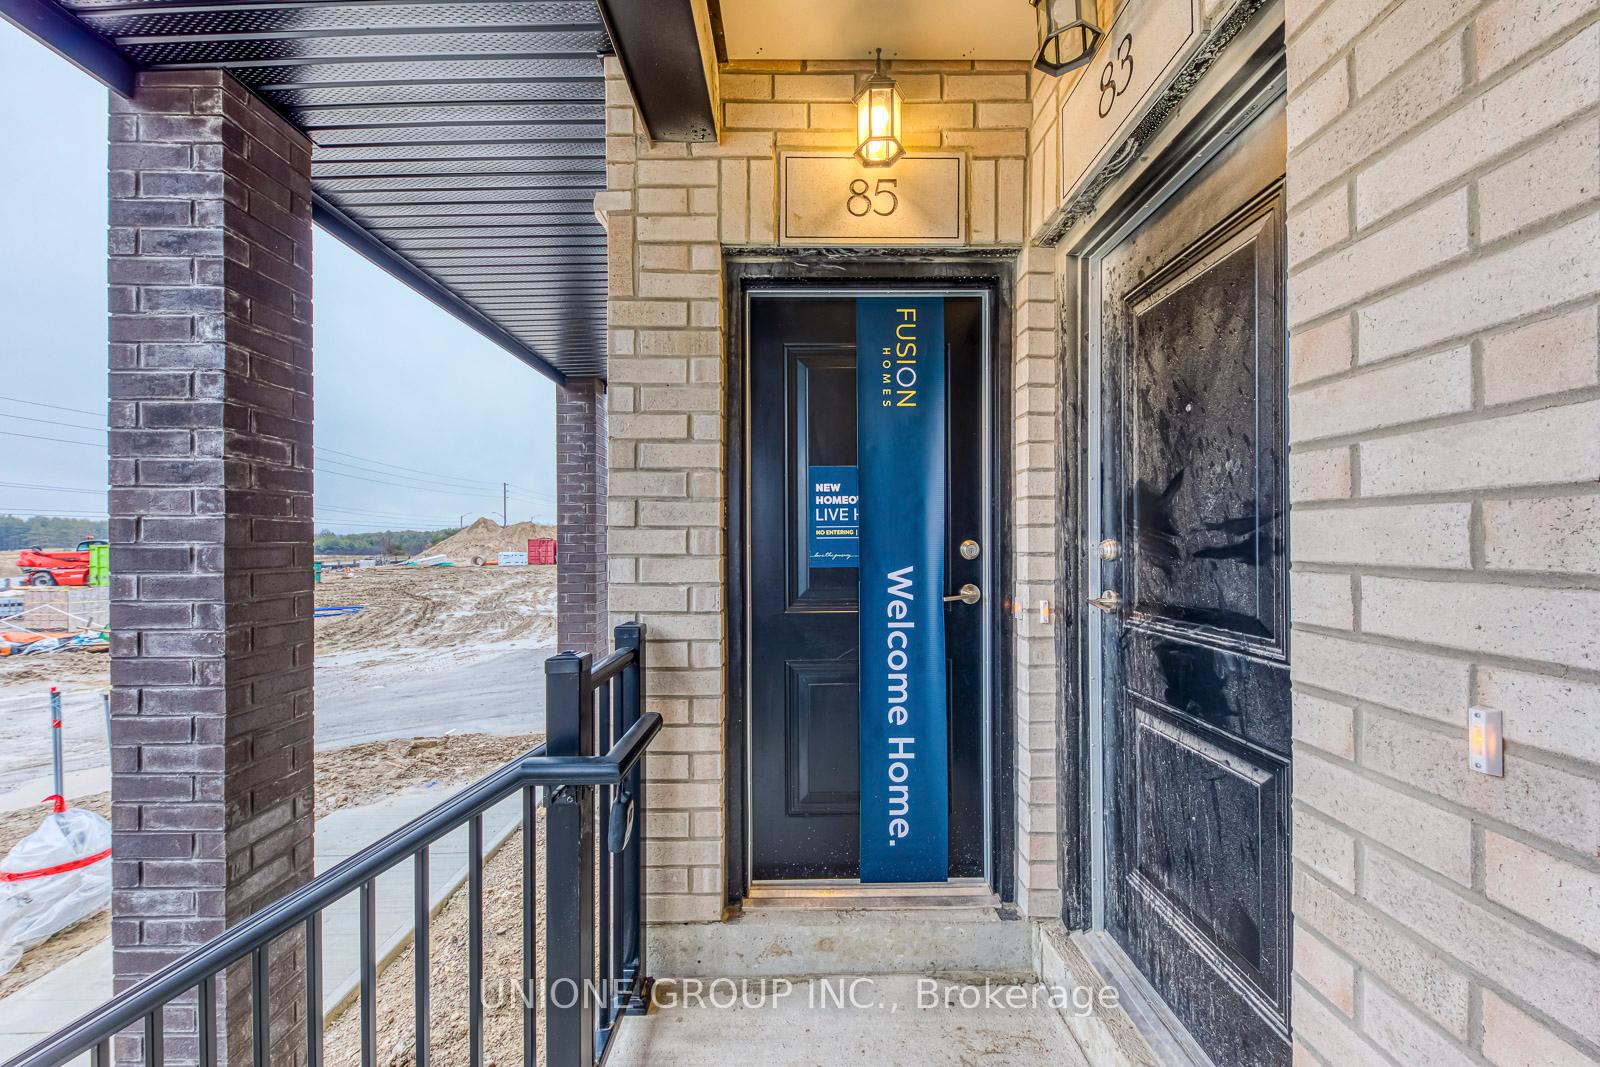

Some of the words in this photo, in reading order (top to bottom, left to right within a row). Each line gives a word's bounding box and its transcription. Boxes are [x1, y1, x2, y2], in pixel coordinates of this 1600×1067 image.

[1098, 33, 1134, 119] 83
[846, 178, 898, 217] 85
[882, 347, 892, 407] HOMES
[895, 308, 917, 407] FUSION
[815, 483, 841, 492] NEW
[815, 495, 859, 505] HOMEO
[815, 508, 849, 521] LIVE
[886, 565, 915, 726] Welcome
[887, 737, 915, 847] Home.
